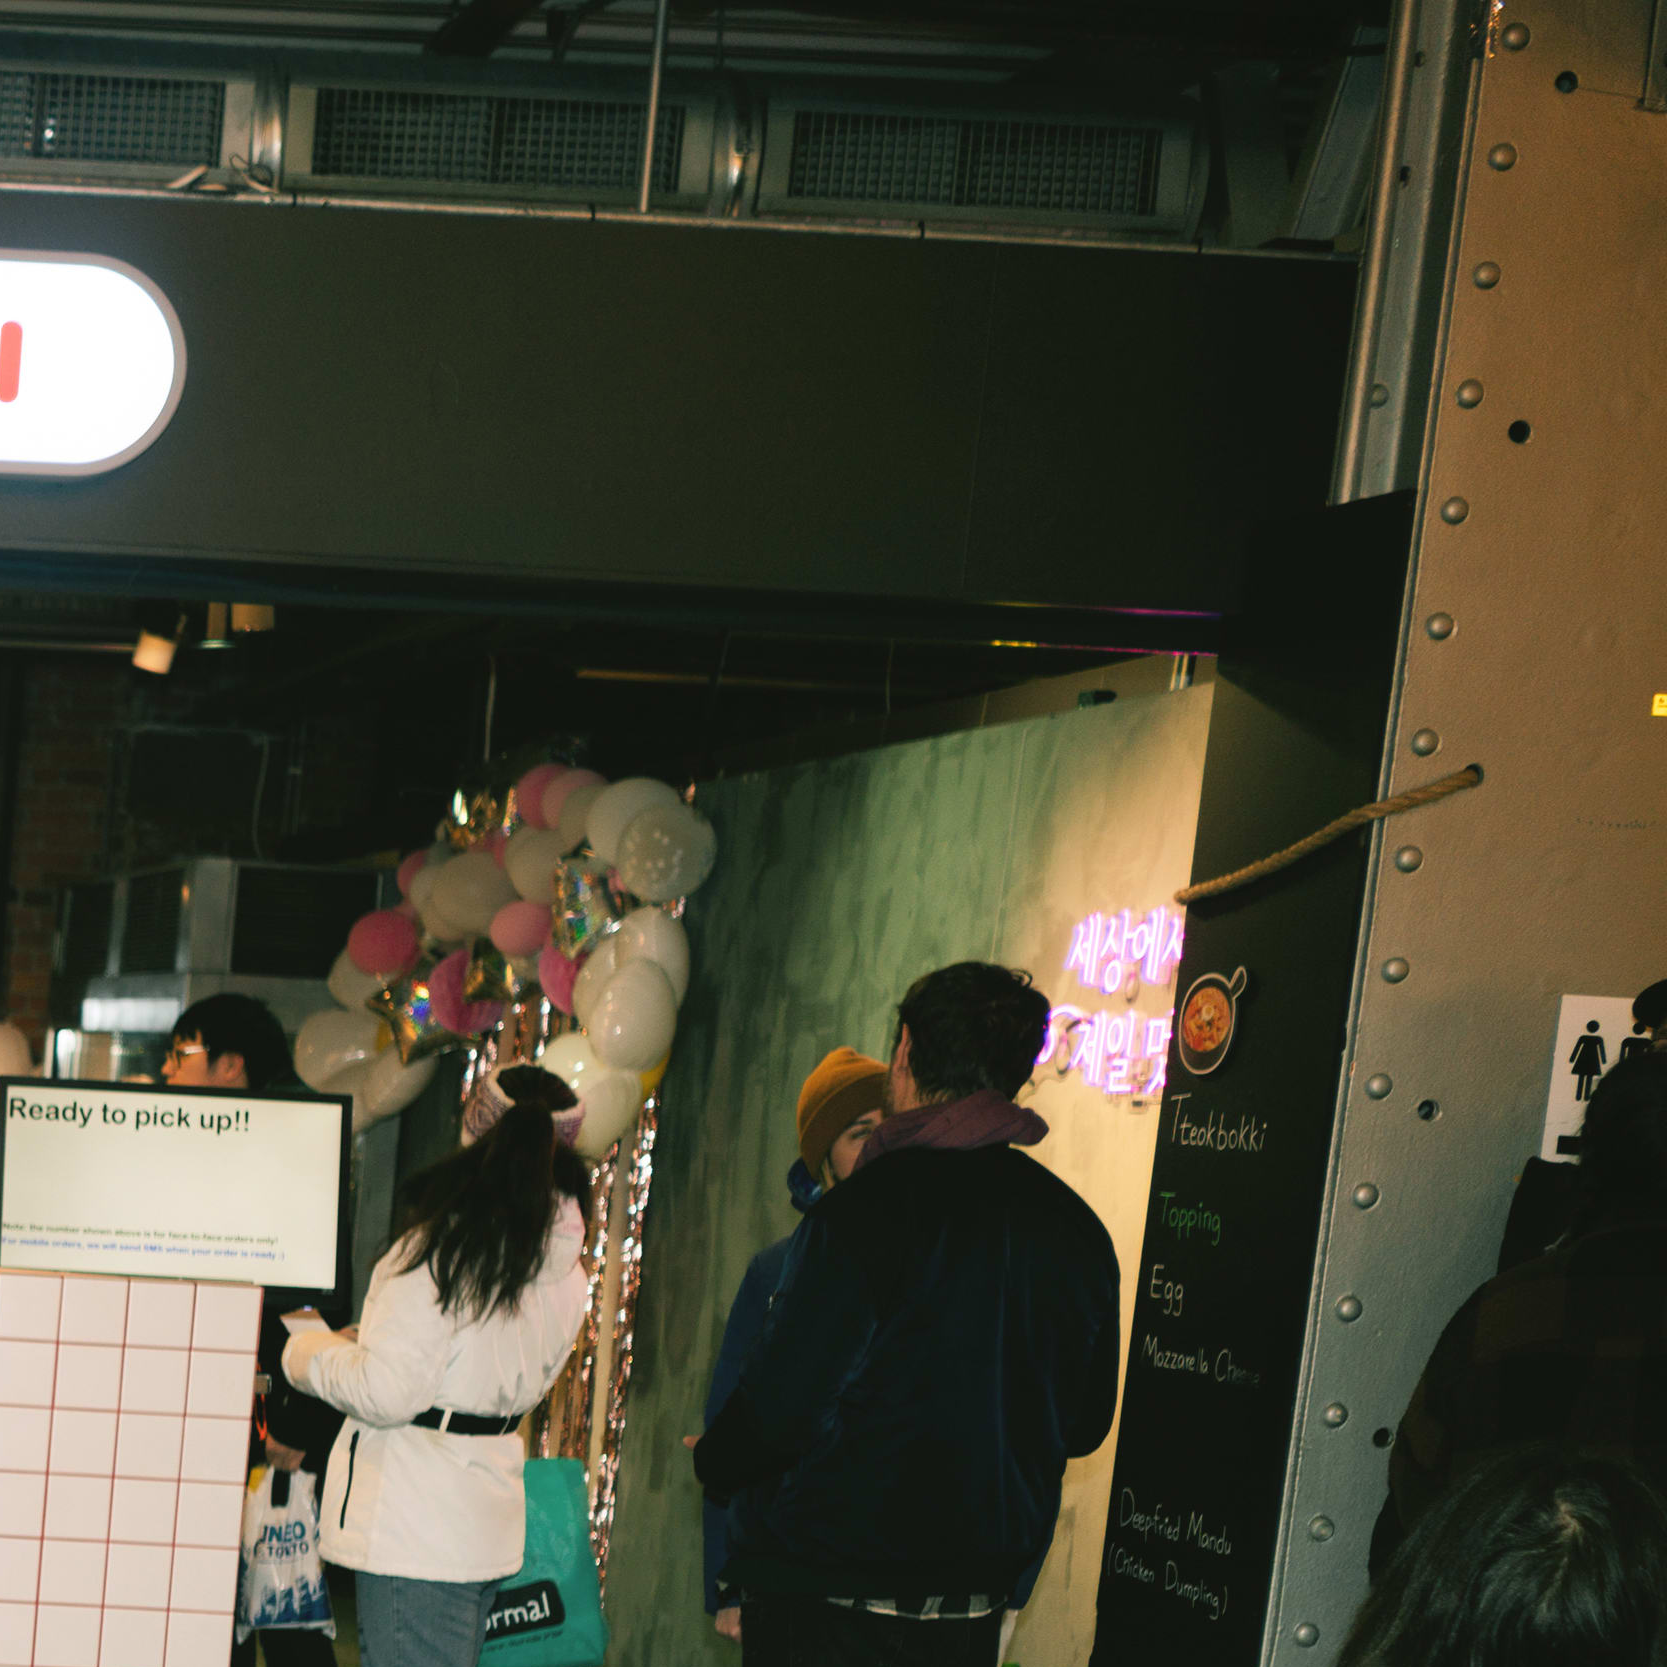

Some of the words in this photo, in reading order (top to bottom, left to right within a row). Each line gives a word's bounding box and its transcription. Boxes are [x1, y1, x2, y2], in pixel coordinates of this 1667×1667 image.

[9, 1097, 93, 1128] Ready
[102, 1103, 127, 1124] to
[135, 1105, 191, 1131] pick
[200, 1110, 251, 1135] up!!
[1171, 1092, 1267, 1152] Tteokbokki
[1159, 1191, 1222, 1247] Topping
[1150, 1264, 1184, 1317] Egg
[1142, 1333, 1209, 1375] Mozzarella
[1186, 1510, 1233, 1555] Mandu
